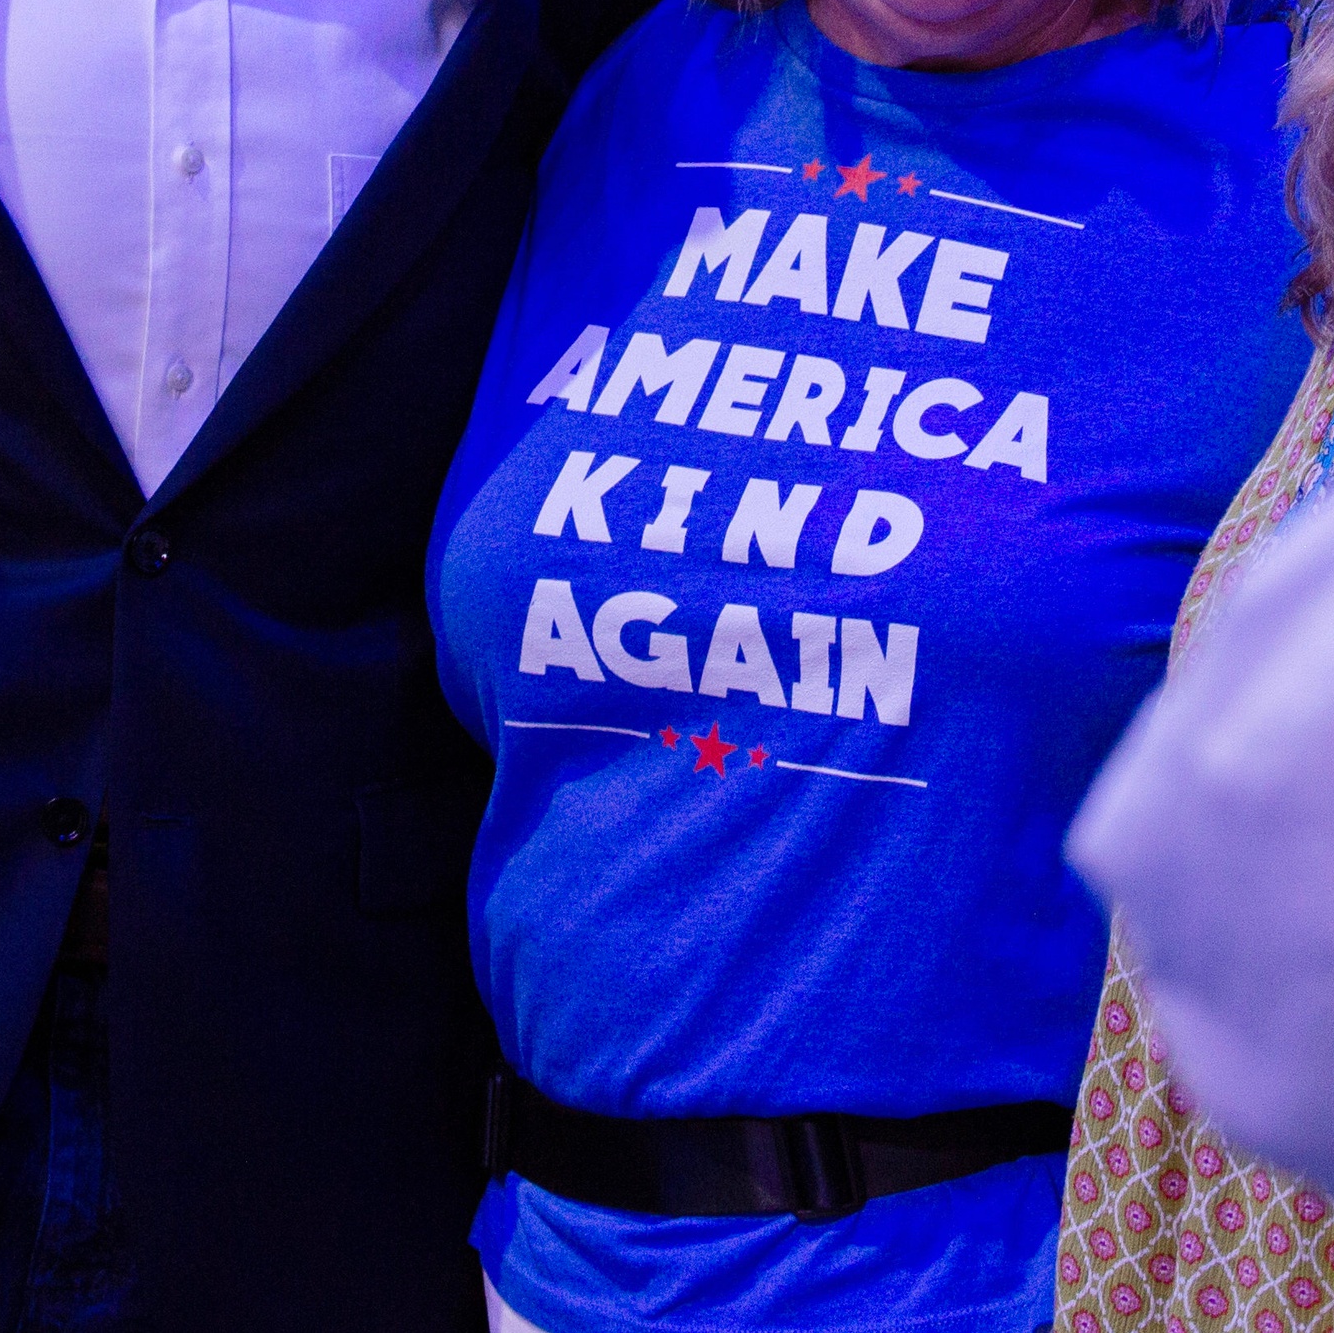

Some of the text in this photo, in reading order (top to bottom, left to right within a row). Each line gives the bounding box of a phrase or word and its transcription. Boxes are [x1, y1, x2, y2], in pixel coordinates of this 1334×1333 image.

[663, 207, 1010, 344] MAKE
[526, 324, 1050, 483] AMERICA
[533, 451, 925, 577] KIND
[519, 578, 920, 726] AGAIN
